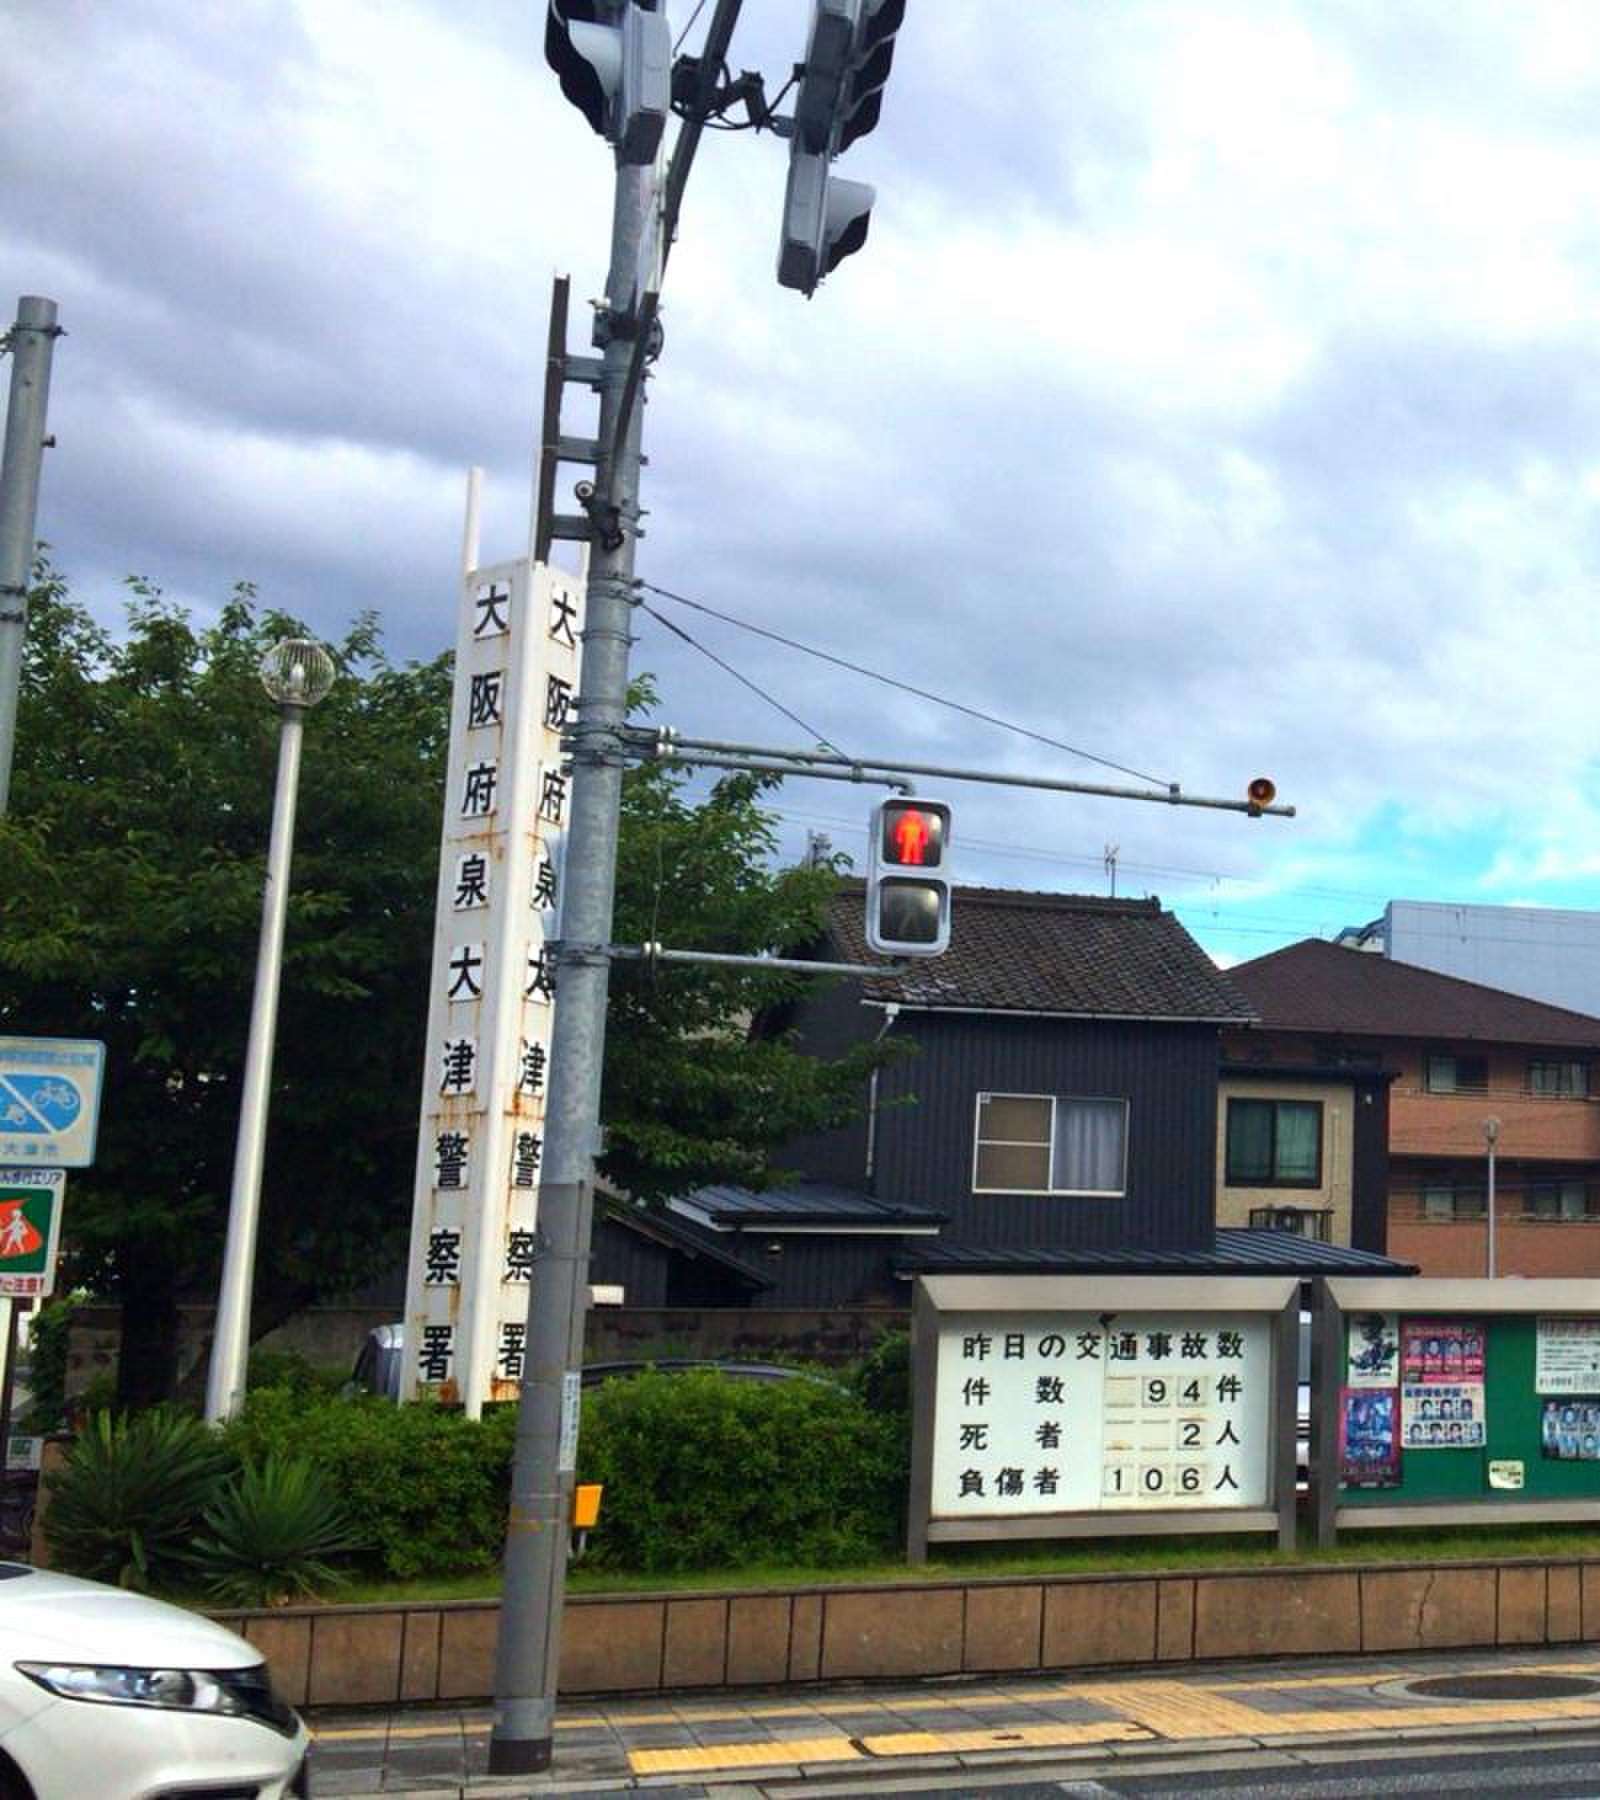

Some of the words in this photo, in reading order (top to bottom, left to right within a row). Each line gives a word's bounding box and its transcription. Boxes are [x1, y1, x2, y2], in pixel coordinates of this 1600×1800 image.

[418, 583, 509, 1381] 大阪府泉大津警察署
[962, 1331, 1245, 1361] 昨日の交通事故数
[959, 1467, 1061, 1497] 負傷者
